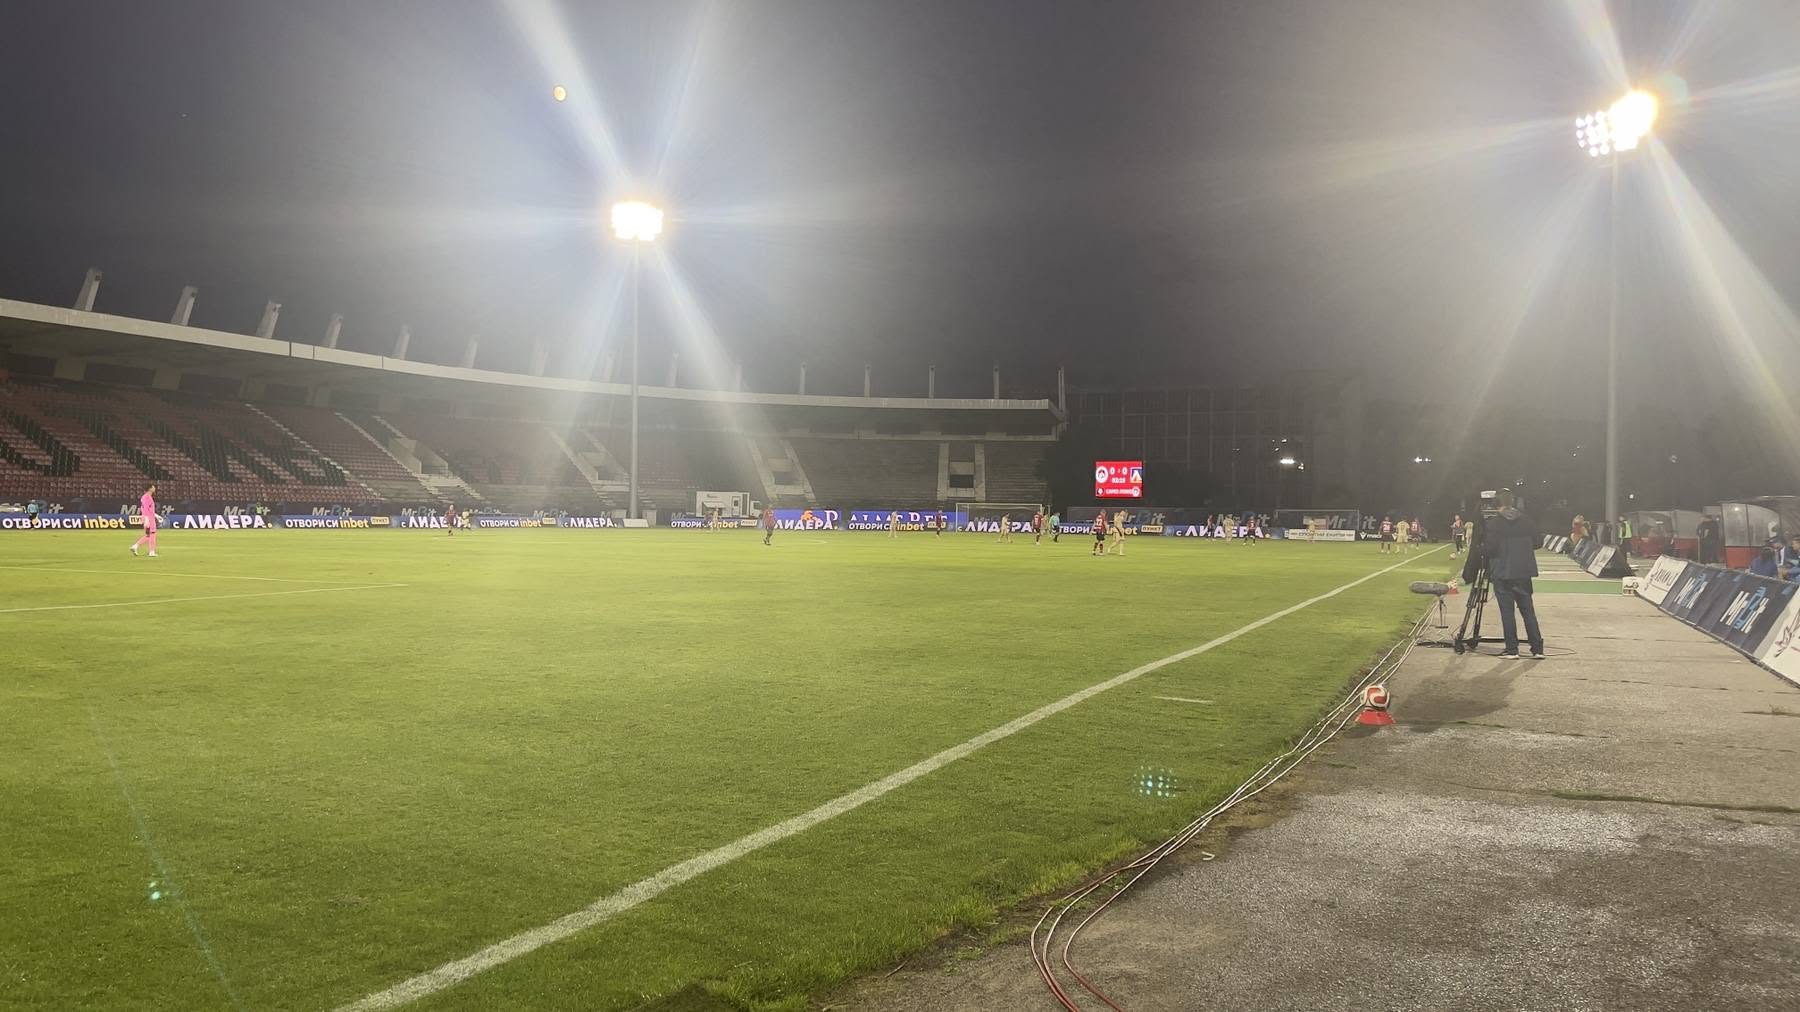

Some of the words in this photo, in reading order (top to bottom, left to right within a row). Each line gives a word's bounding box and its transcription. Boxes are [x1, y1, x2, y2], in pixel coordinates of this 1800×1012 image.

[62, 518, 82, 529] СИ
[83, 515, 126, 529] inbet
[285, 519, 325, 528] ОТВОРИ
[326, 519, 339, 528] СИ
[340, 516, 369, 529] inbet
[480, 519, 509, 528] ОТВОРИ
[520, 518, 542, 528] inbet
